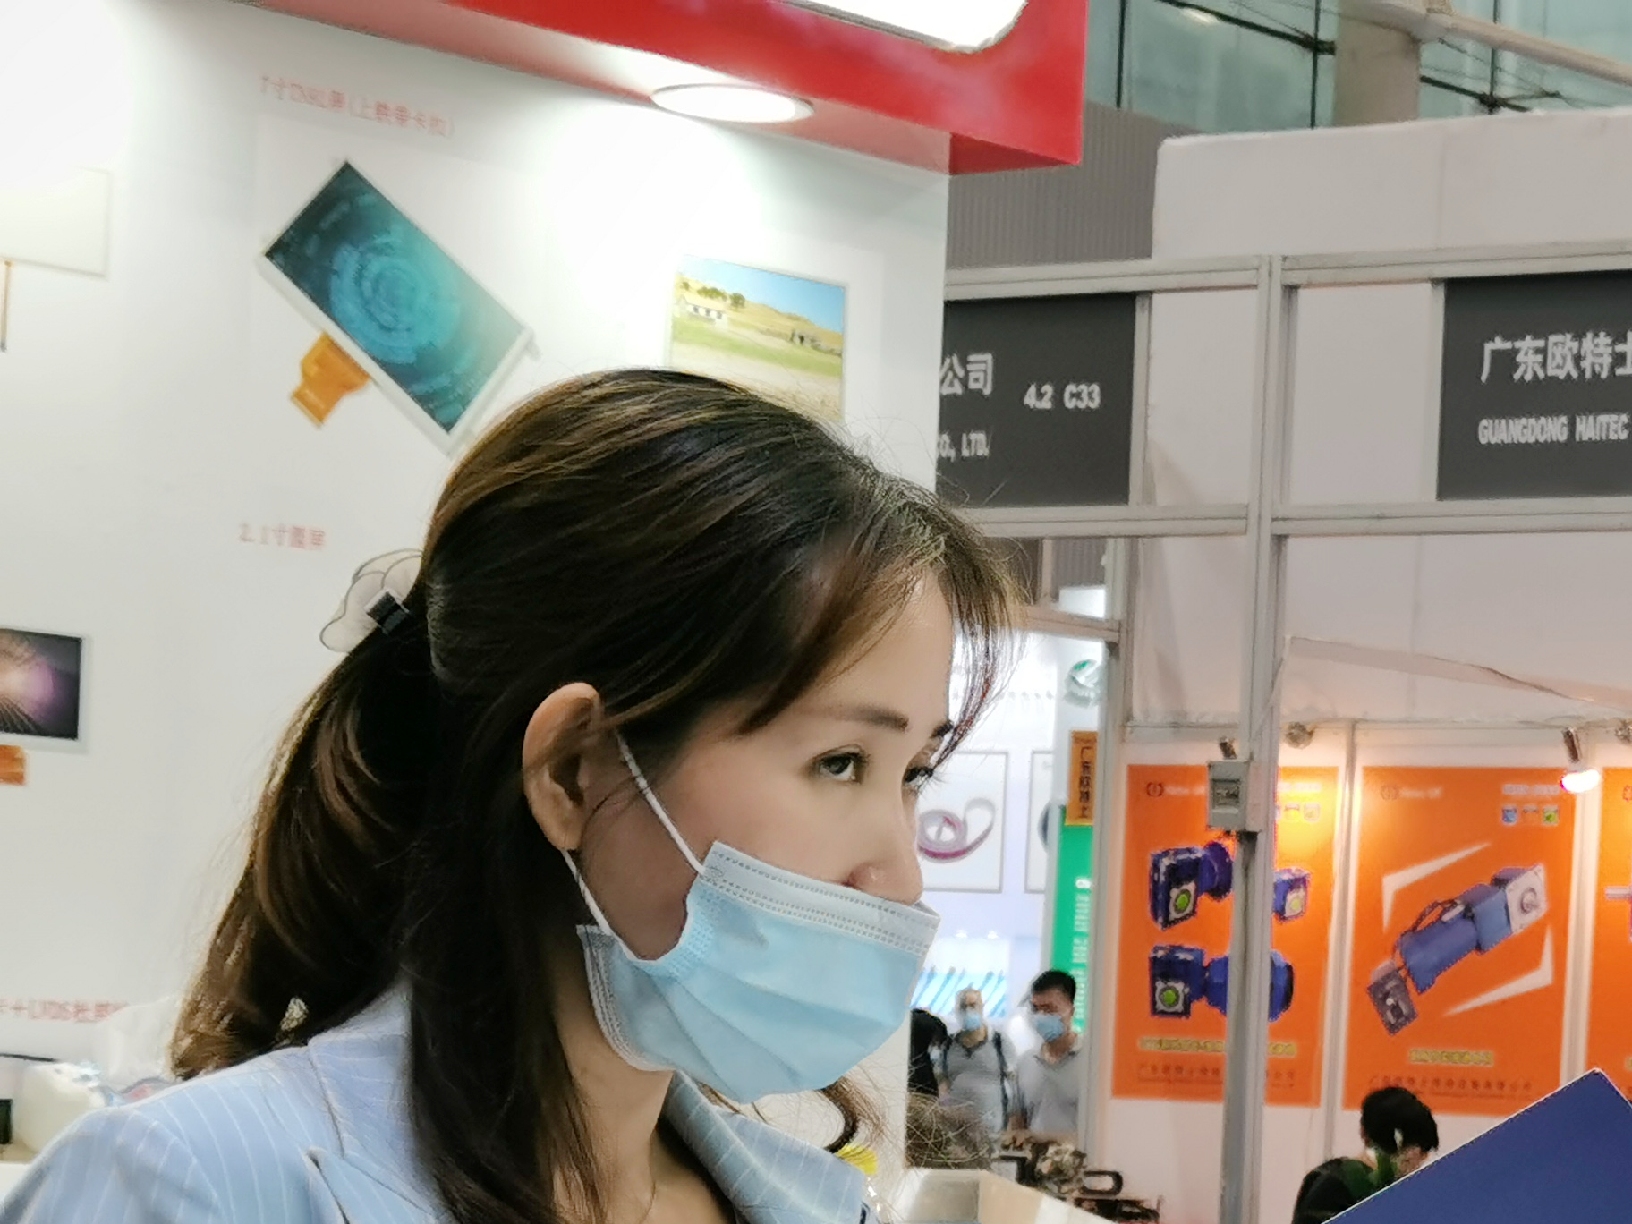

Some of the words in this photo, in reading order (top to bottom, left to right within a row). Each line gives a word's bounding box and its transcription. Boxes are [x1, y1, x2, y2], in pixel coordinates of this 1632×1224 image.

[1023, 382, 1053, 410] 4.2
[1063, 382, 1102, 410] C33
[1478, 414, 1569, 446] GUANGDONG
[1576, 412, 1629, 442] HAITEC
